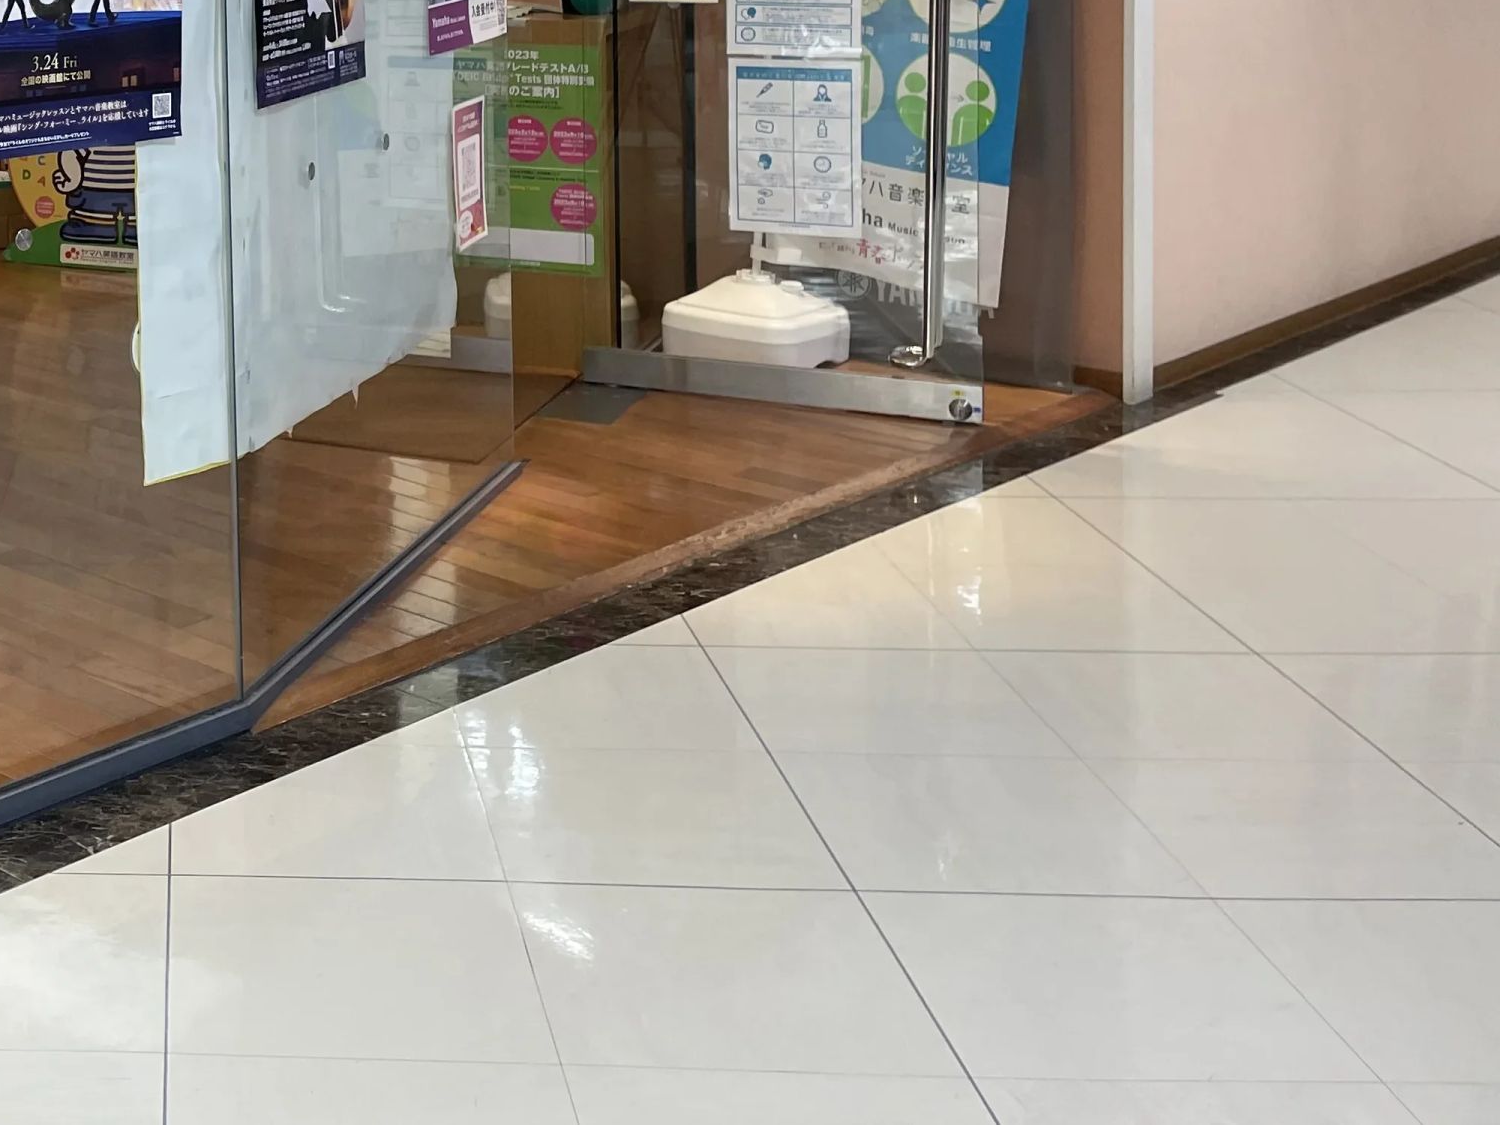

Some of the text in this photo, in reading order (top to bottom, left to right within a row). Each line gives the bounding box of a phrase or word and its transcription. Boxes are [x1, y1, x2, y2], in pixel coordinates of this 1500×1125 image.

[31, 52, 78, 73] 3.24 Fri
[20, 69, 91, 87] 全国の映画館にて公開
[888, 222, 919, 237] Music
